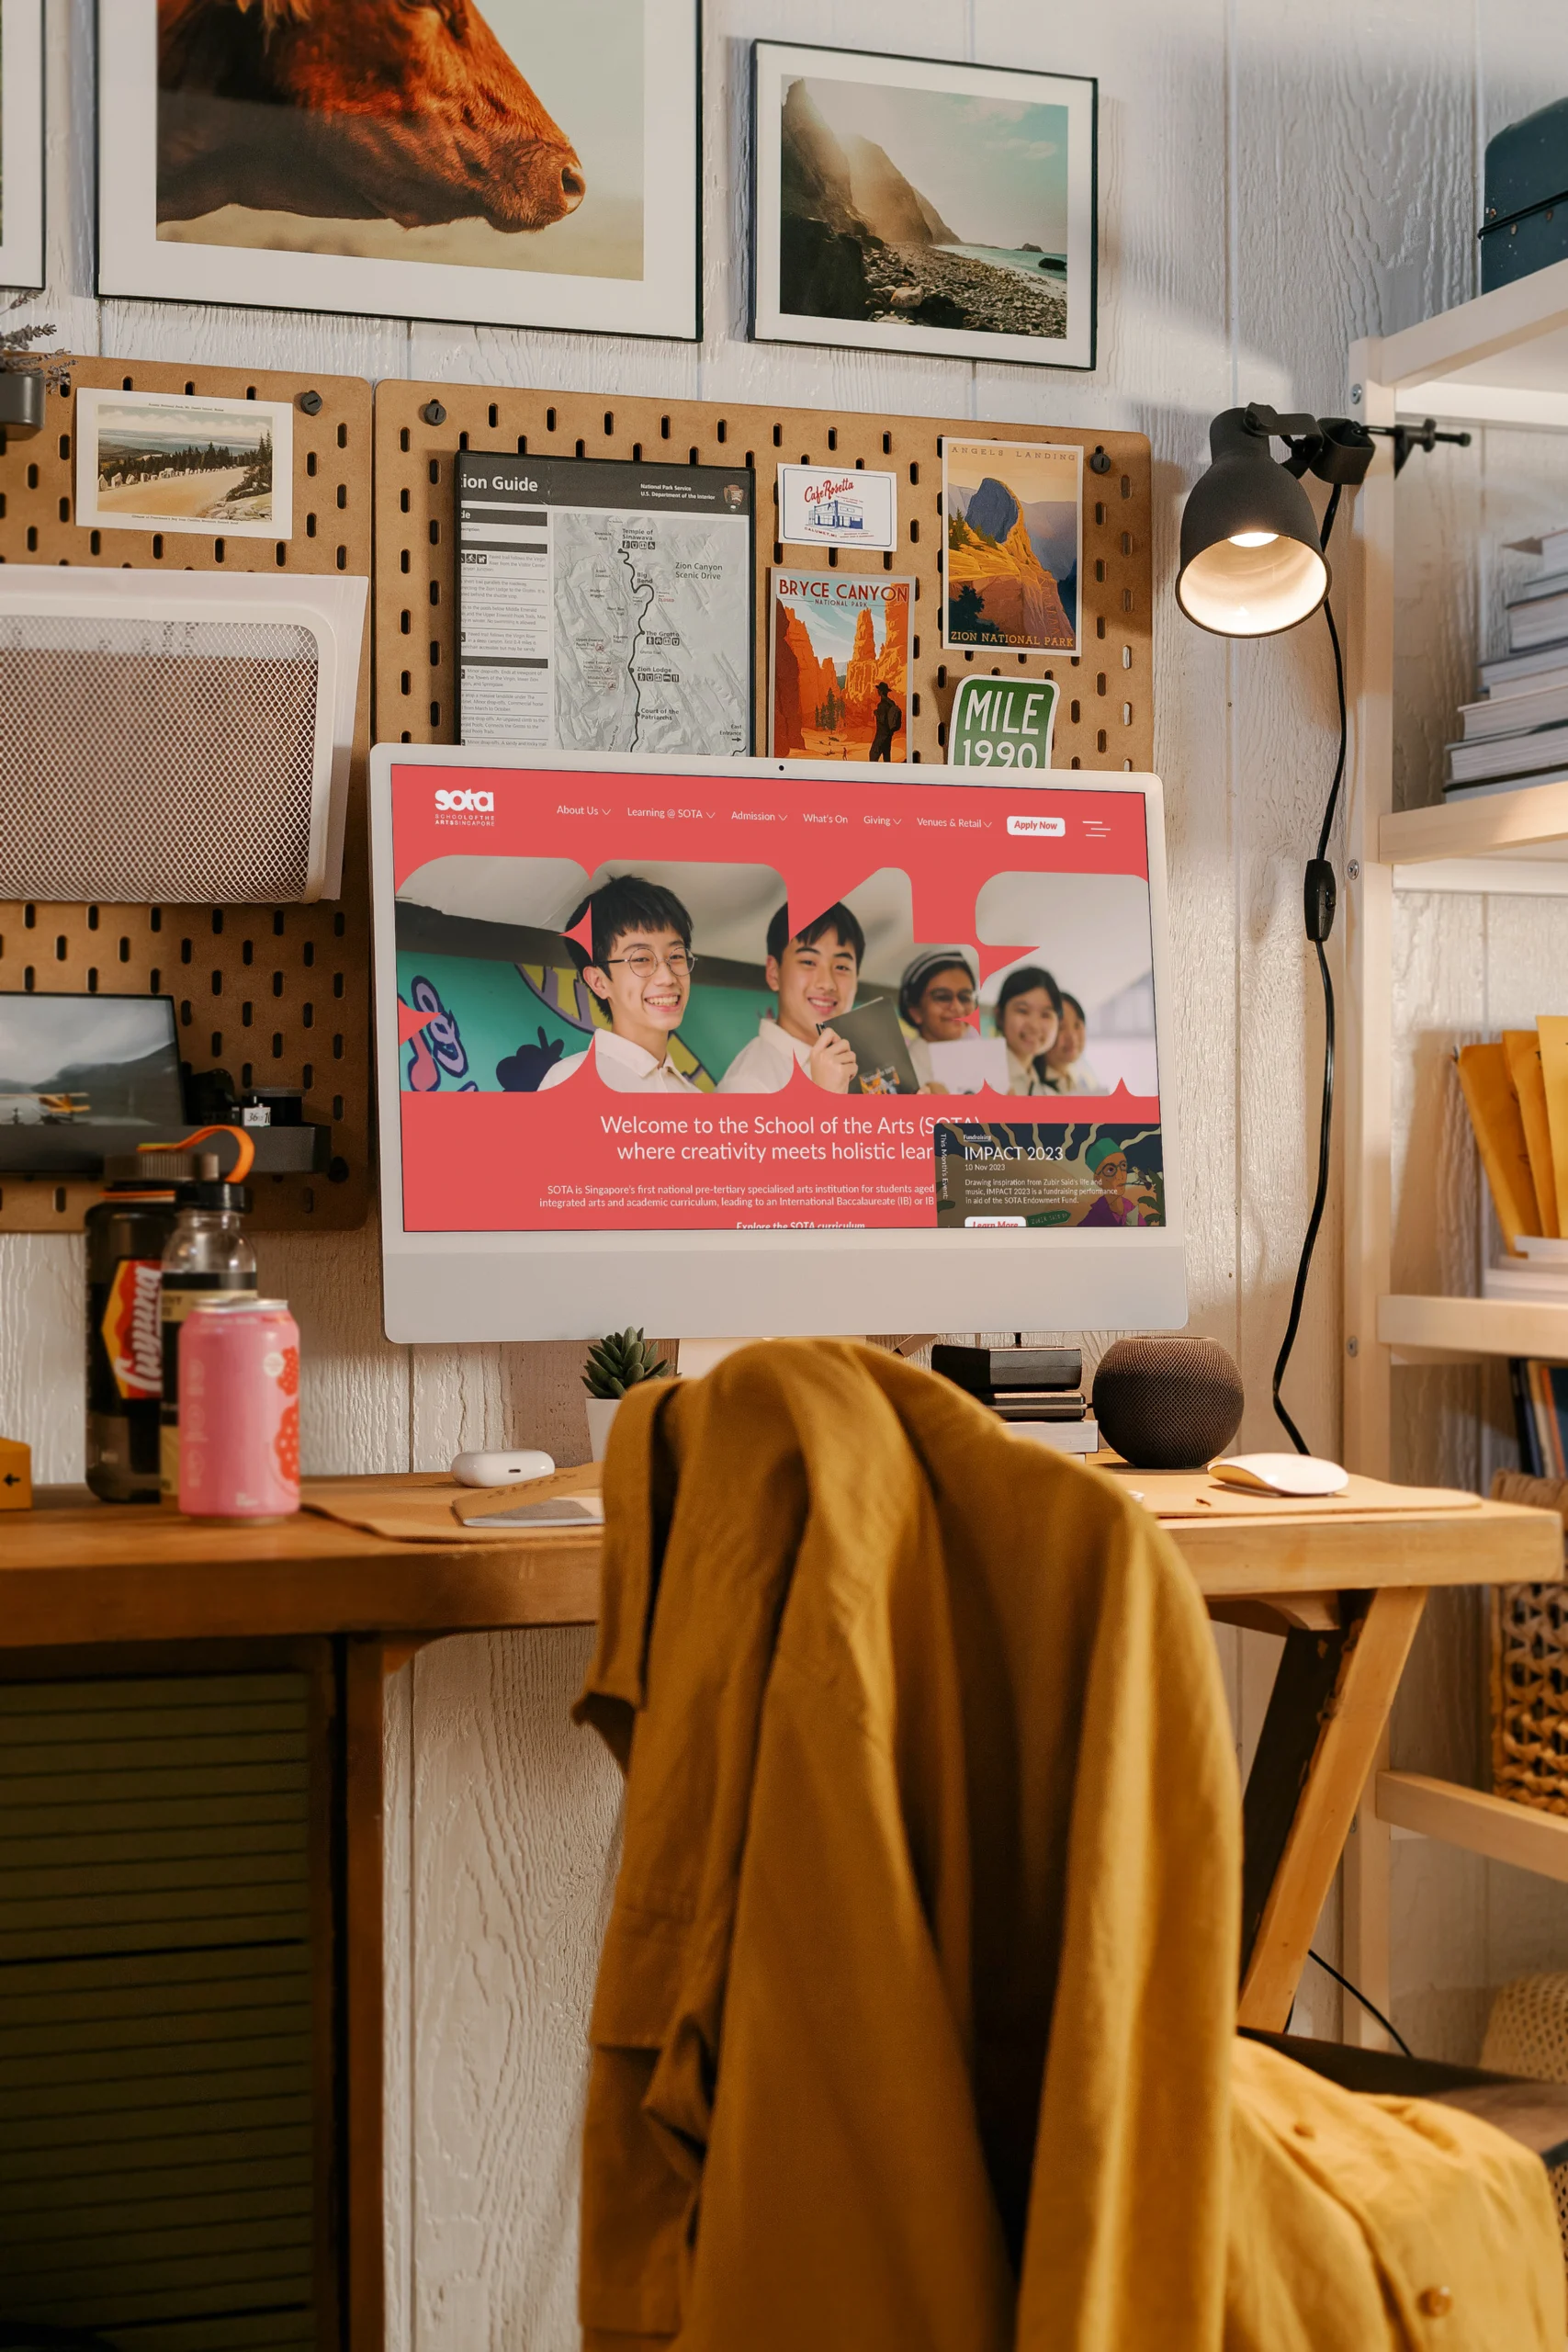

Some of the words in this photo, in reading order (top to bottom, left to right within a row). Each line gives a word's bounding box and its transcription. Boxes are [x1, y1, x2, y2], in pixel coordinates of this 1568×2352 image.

[952, 447, 1004, 457] ANGELS
[1016, 452, 1076, 461] LANDING
[492, 476, 537, 492] Guide
[805, 485, 823, 503] Cafe
[823, 478, 854, 500] Rosetta
[694, 563, 722, 571] Canyon
[779, 579, 829, 598] BRYCE
[836, 582, 908, 603] CANYON
[951, 632, 977, 642] ZION
[982, 634, 1040, 645] NATIONAL
[1044, 637, 1073, 647] PARK
[965, 690, 1043, 735] MILE
[963, 740, 1038, 768] 1990
[557, 805, 584, 814] About
[586, 806, 598, 814] Us
[627, 808, 664, 819] Learning
[667, 808, 675, 818] @
[678, 808, 703, 818] SOTA
[731, 810, 774, 820] Admission
[803, 813, 832, 822] What's
[834, 814, 847, 823] On
[863, 815, 891, 826] Giving
[917, 818, 946, 826] Venues
[950, 818, 955, 826] &
[958, 819, 982, 827] Retail
[1014, 820, 1037, 831] Apply
[248, 1113, 258, 1121] 36
[601, 1115, 687, 1133] Welcome
[694, 1117, 712, 1133] to
[718, 1116, 748, 1133] the
[754, 1116, 813, 1133] School
[820, 1116, 838, 1133] of
[843, 1116, 872, 1134] the
[877, 1117, 913, 1134] Arts
[617, 1141, 674, 1159] where
[682, 1142, 766, 1162] creativity
[772, 1144, 826, 1159] meets
[832, 1142, 895, 1159] holistic
[901, 1141, 933, 1159] lear
[964, 1147, 1022, 1159] IMPACT
[1027, 1147, 1062, 1159] 2023
[547, 1185, 573, 1193] SOTA
[575, 1185, 581, 1193] is
[584, 1185, 635, 1195] Singapore's
[637, 1184, 655, 1193] first
[658, 1184, 693, 1193] national
[695, 1184, 745, 1194] pre-tertiary
[748, 1184, 794, 1194] specialised
[816, 1184, 858, 1193] institution
[862, 1184, 873, 1193] for
[875, 1184, 911, 1193] students
[914, 1183, 934, 1194] aged
[964, 1179, 991, 1187] Drawing
[1043, 1187, 1077, 1195] fundraising
[539, 1198, 585, 1208] integrated
[607, 1197, 624, 1206] and
[626, 1197, 667, 1206] academic
[670, 1197, 718, 1206] curriculum,
[721, 1197, 752, 1207] leading
[780, 1196, 833, 1205] International
[837, 1196, 895, 1204] Baccalaureate
[897, 1196, 911, 1205] (IB)
[925, 1196, 933, 1204] IB
